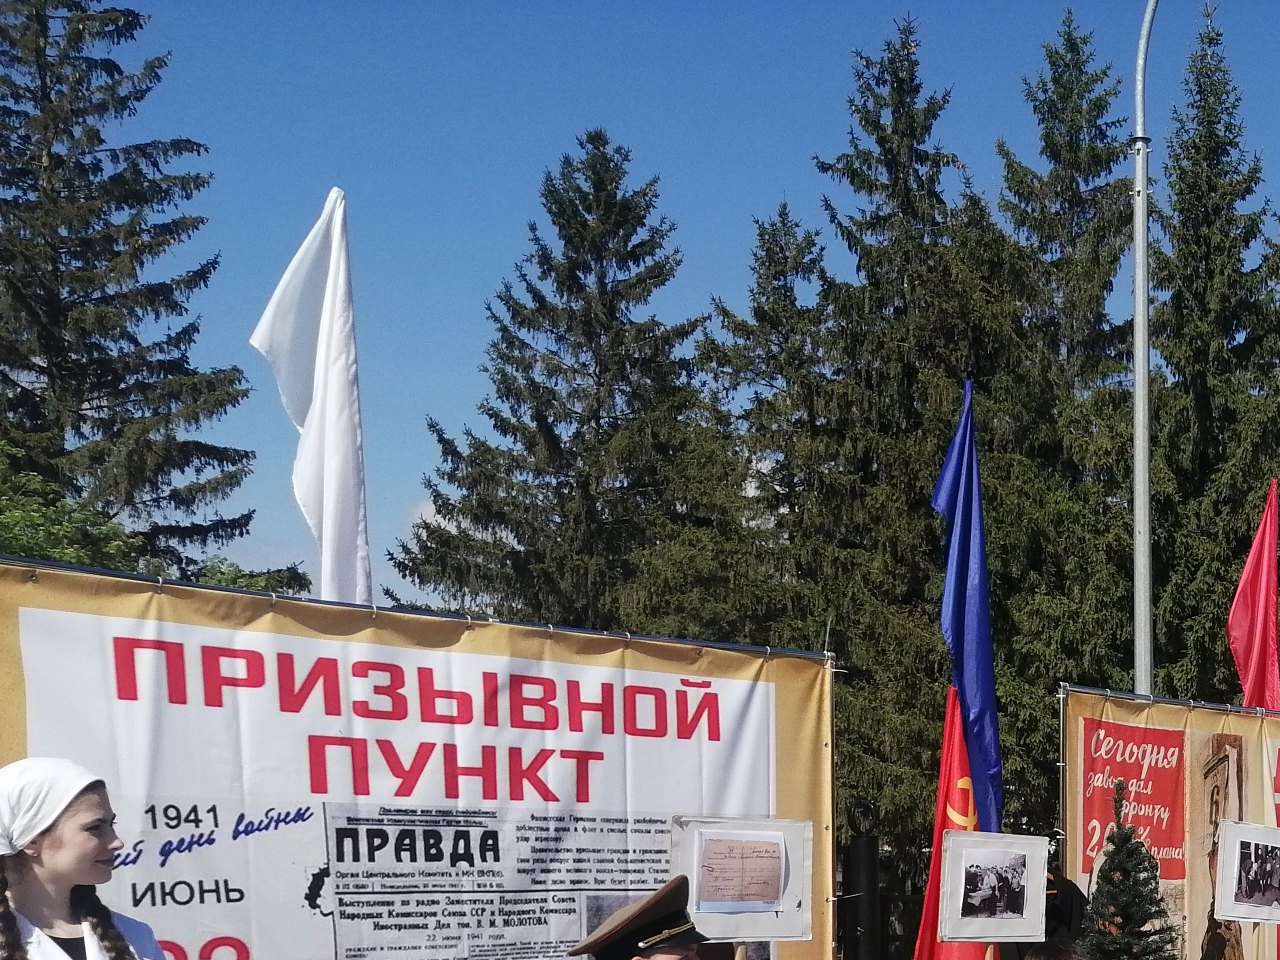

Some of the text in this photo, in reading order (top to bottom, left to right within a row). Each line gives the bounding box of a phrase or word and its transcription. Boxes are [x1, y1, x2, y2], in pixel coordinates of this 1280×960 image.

[113, 637, 720, 742] ПРИЗЫВНОЙ
[1092, 729, 1179, 780] Сегодня
[308, 735, 604, 804] ПУНКТ
[1128, 779, 1153, 802] дал
[145, 804, 219, 829] 1941
[159, 830, 216, 868] день
[232, 806, 314, 841] войны
[336, 828, 500, 867] ПРАВДА
[131, 879, 245, 908] ИЮНЬ
[338, 897, 395, 908] Выступление
[552, 894, 576, 903] Совета
[434, 920, 450, 929] Дел
[503, 916, 548, 928] МОЛОТОВА
[470, 908, 486, 917] ССР
